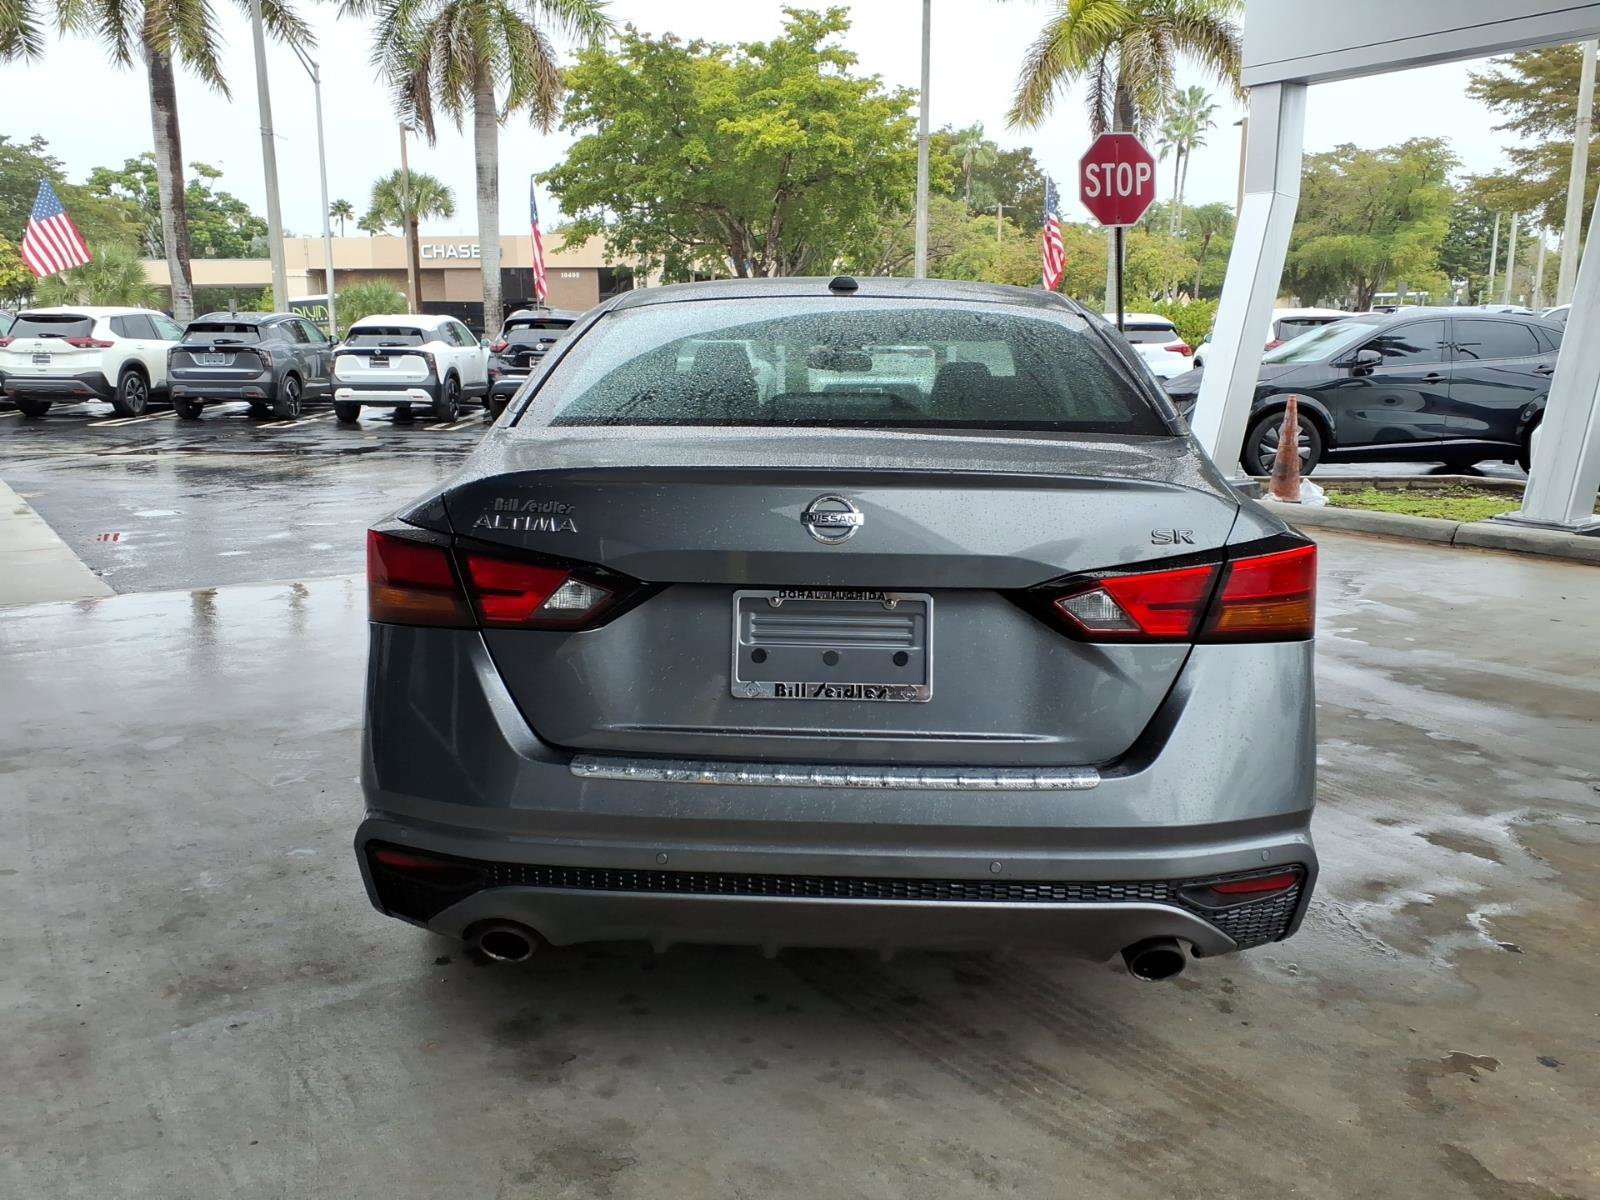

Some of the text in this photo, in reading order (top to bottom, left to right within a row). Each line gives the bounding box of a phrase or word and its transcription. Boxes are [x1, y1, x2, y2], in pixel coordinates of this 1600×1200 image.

[1085, 162, 1151, 197] STOP
[421, 244, 480, 259] CHASE
[494, 498, 519, 511] Bill
[472, 514, 578, 533] ALTIMA
[807, 514, 857, 523] NISSAN
[1151, 528, 1195, 545] SR
[774, 683, 806, 697] Bill
